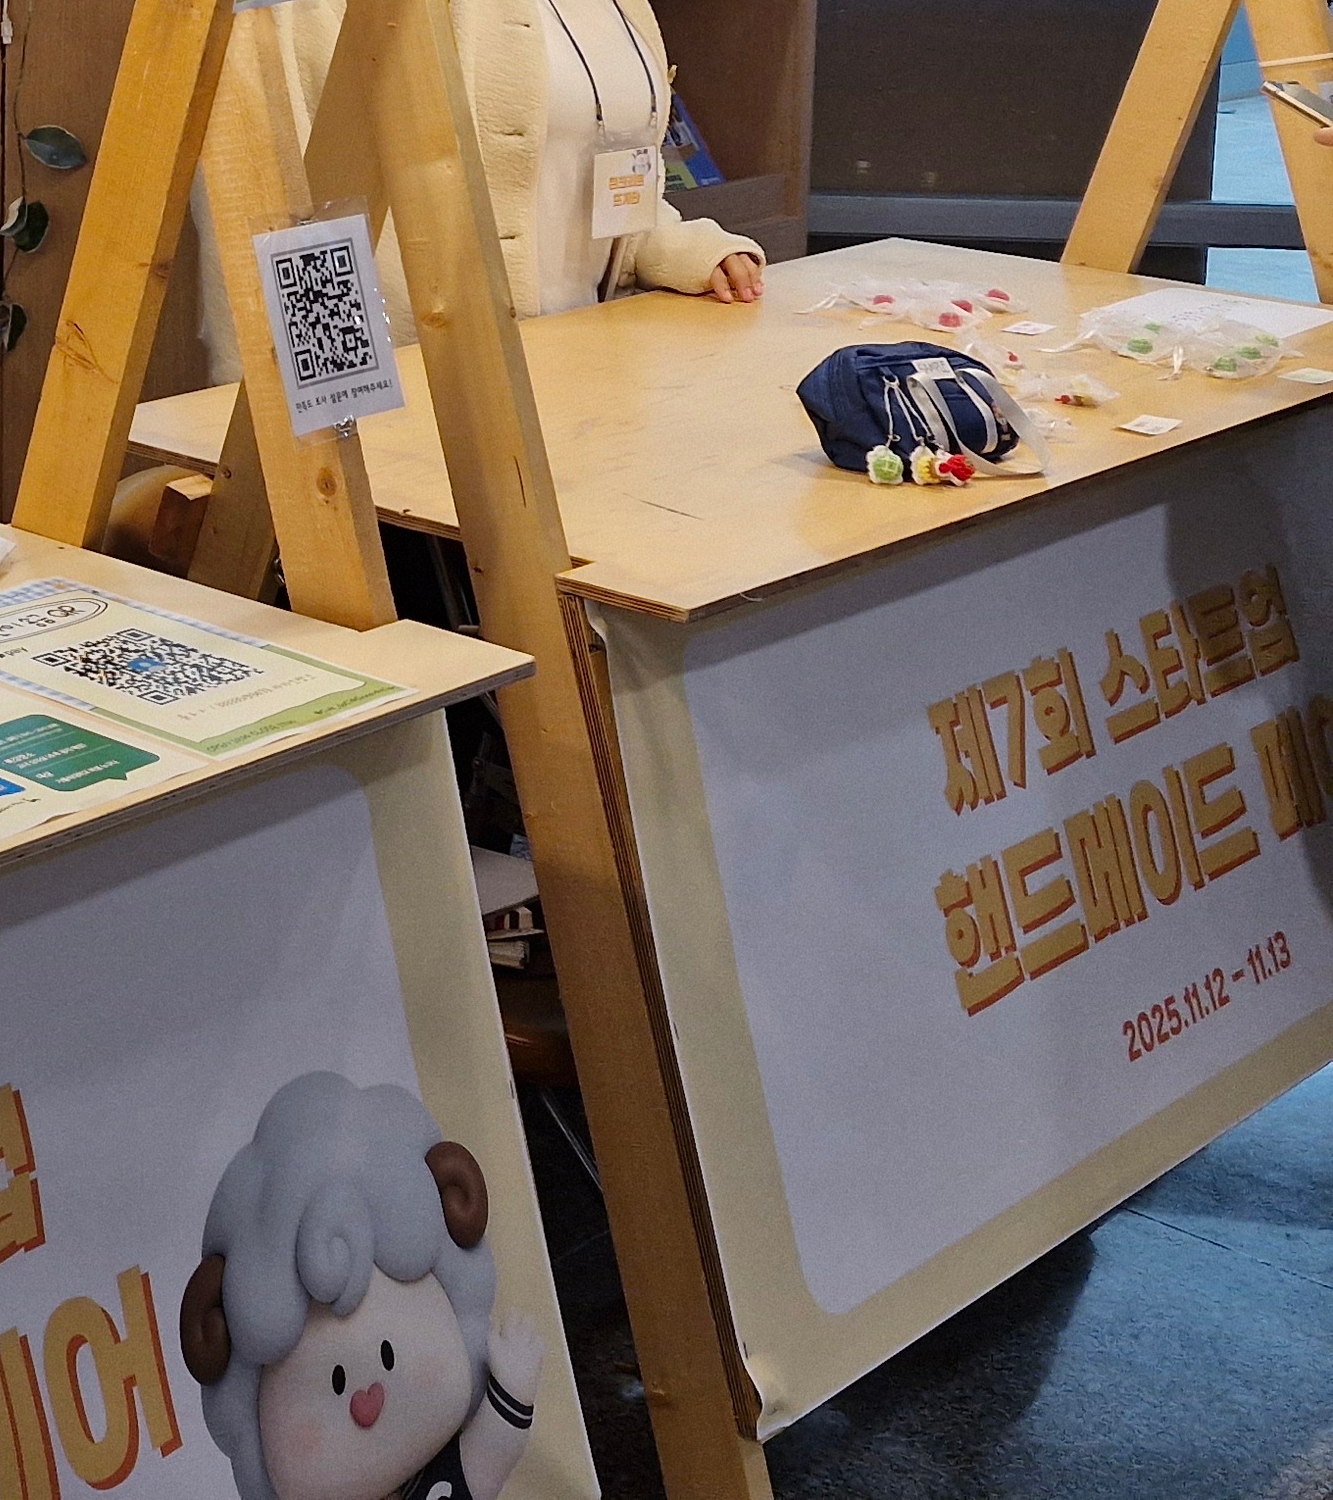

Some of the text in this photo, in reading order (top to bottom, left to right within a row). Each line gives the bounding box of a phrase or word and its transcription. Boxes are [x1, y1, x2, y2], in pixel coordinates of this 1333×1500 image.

[927, 562, 1300, 816] 제7회 스타트업
[935, 742, 1260, 1016] 핸드메이드
[1122, 967, 1231, 1063] 2025.11.12
[1246, 930, 1292, 987] 11.13
